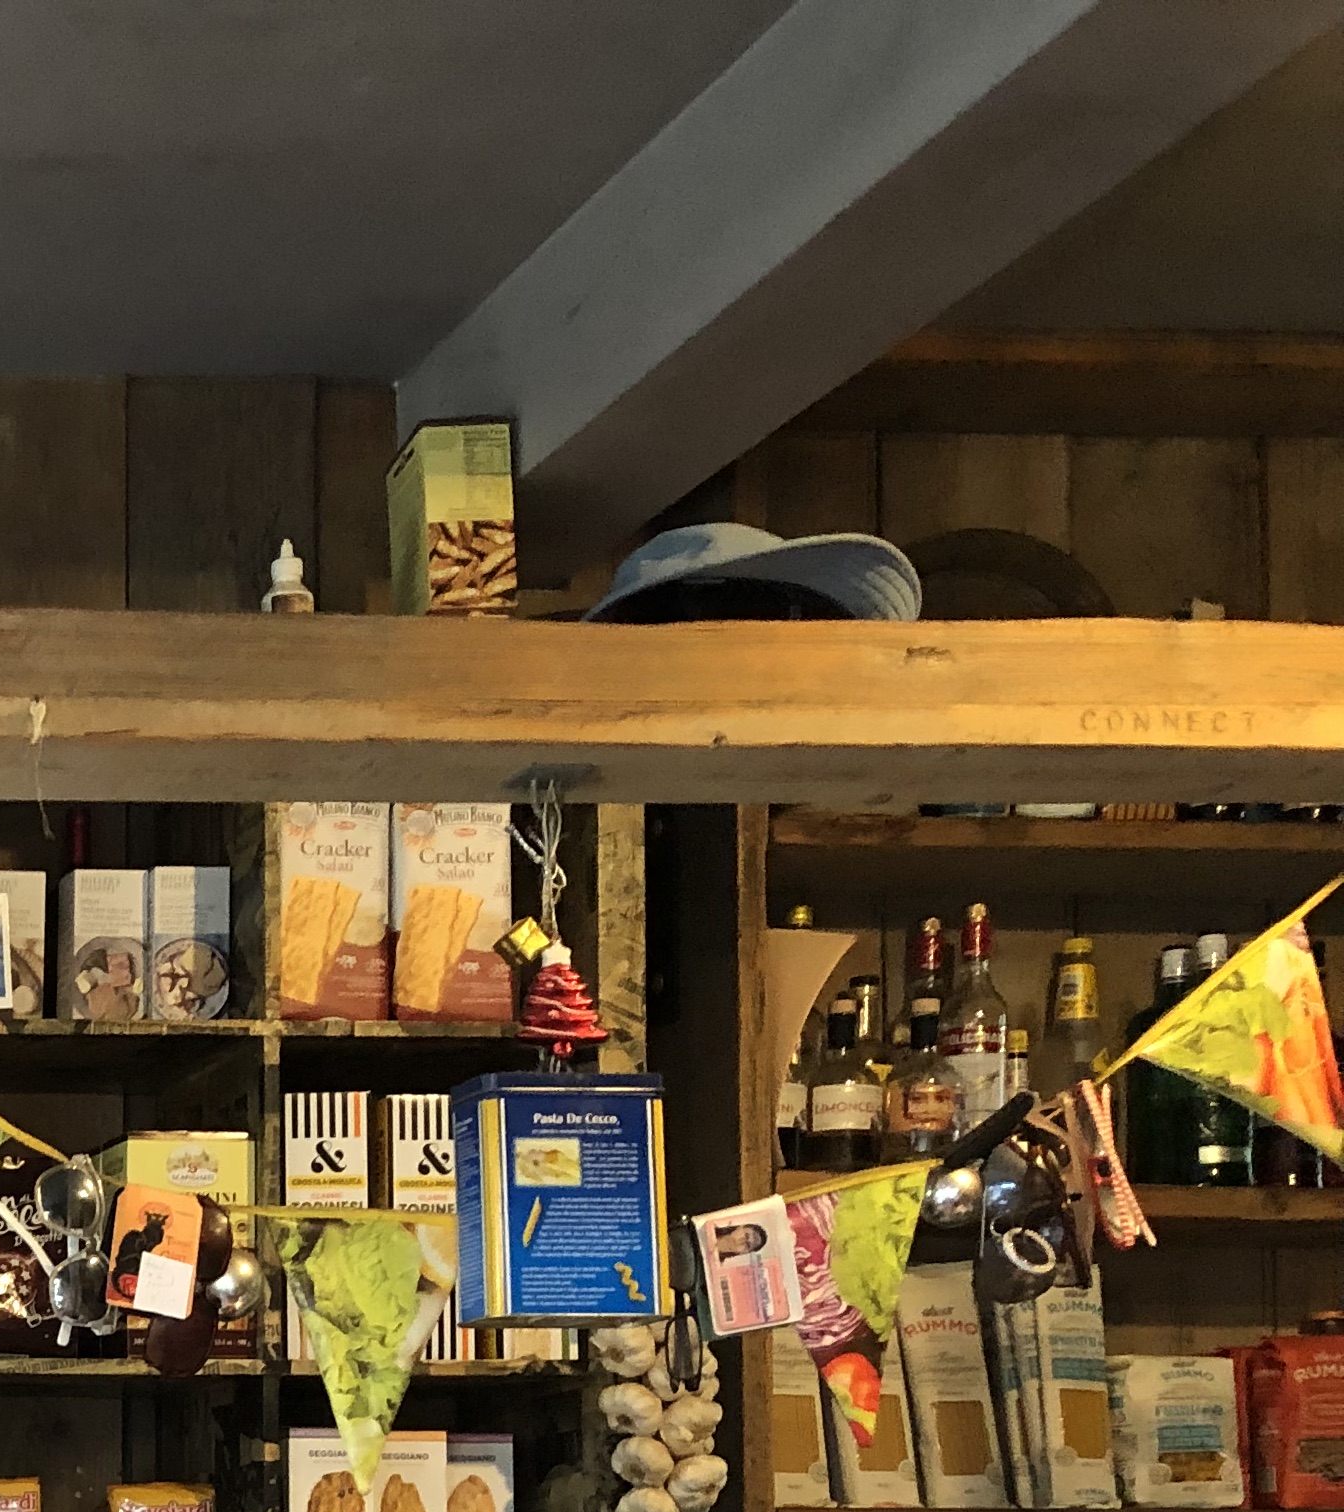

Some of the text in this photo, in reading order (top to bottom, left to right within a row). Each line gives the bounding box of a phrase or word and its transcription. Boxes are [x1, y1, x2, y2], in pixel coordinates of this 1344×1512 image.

[1079, 709, 1256, 733] CONNECT
[300, 840, 372, 857] Cracker
[419, 847, 495, 864] Cracker
[316, 858, 353, 872] Salati
[437, 866, 475, 880] Salati
[533, 1112, 563, 1125] Pasta
[566, 1113, 582, 1124] De
[399, 1203, 455, 1213] TORINE
[904, 1319, 979, 1338] RUMMO
[381, 1453, 430, 1461] SEGGIANO
